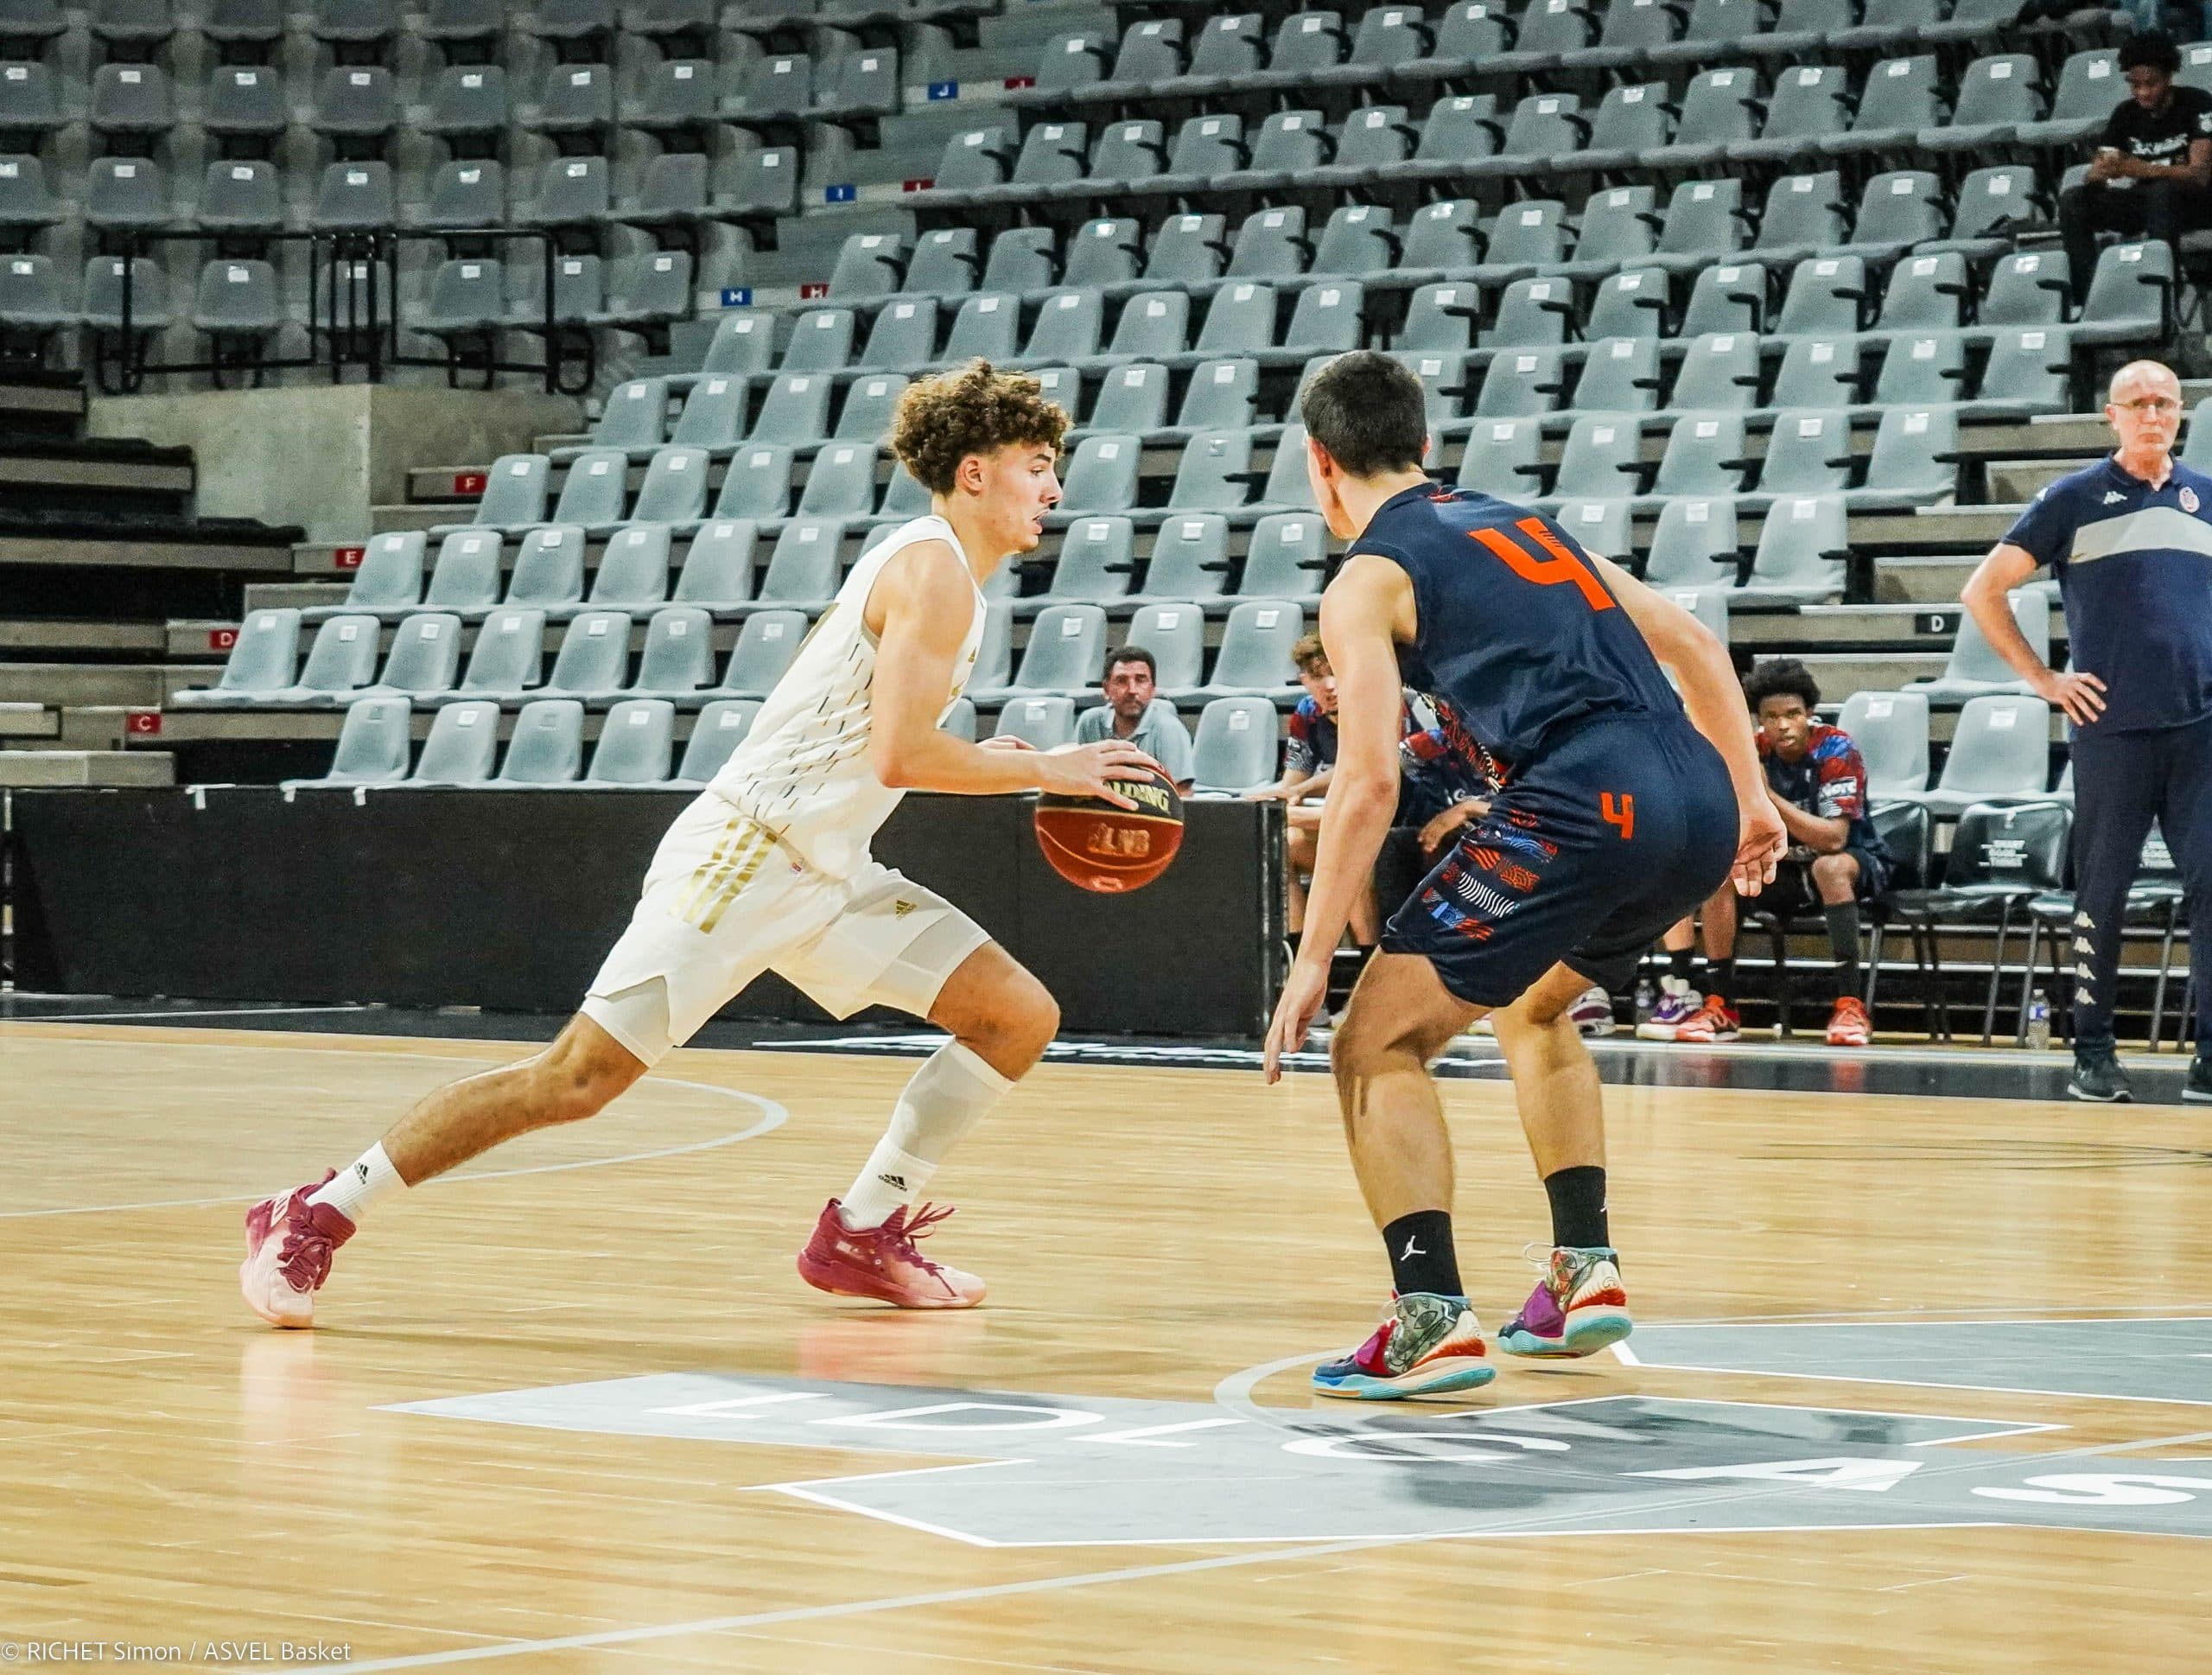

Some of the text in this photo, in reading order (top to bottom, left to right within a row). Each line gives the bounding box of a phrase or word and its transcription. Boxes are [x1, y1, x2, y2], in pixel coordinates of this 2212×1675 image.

[729, 290, 743, 303] H
[810, 286, 823, 299] H
[465, 477, 476, 490] F
[346, 551, 358, 564] E
[1466, 516, 1617, 612] 4
[1931, 614, 1945, 633] D
[219, 632, 233, 646] D
[138, 716, 152, 730] C
[1599, 791, 1635, 840] 4
